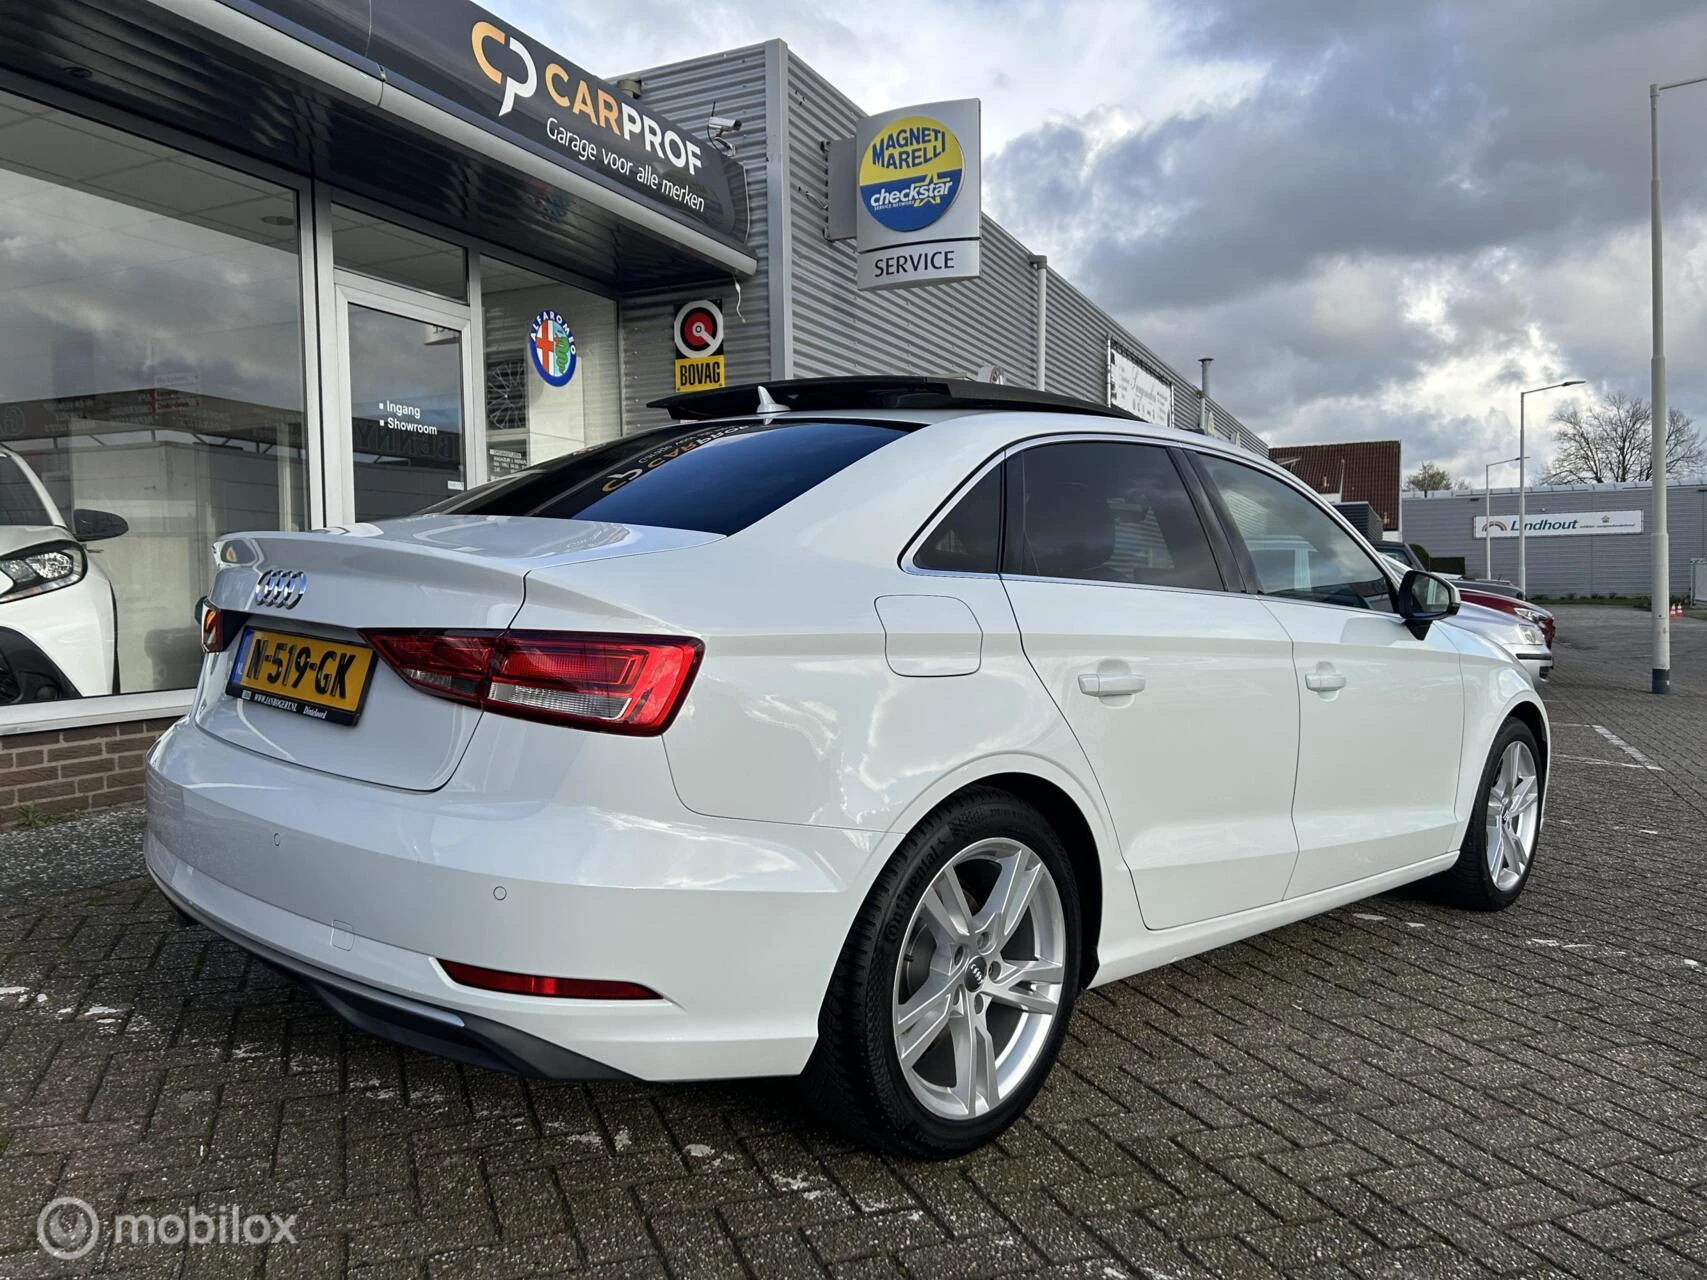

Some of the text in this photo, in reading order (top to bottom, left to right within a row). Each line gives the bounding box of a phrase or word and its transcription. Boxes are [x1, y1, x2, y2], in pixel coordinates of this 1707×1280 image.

[545, 63, 702, 175] CARPROF
[872, 126, 946, 163] MAGNETI
[872, 138, 946, 170] MARELLI
[546, 117, 705, 213] Garage voor alle merken
[870, 180, 953, 207] checkstar
[875, 250, 955, 278] SERVICE
[680, 361, 721, 386] BOVAG
[386, 400, 421, 419] Ingang
[387, 417, 438, 435] Showroom
[1510, 519, 1579, 531] Lndhout
[246, 639, 356, 699] N-519-GK
